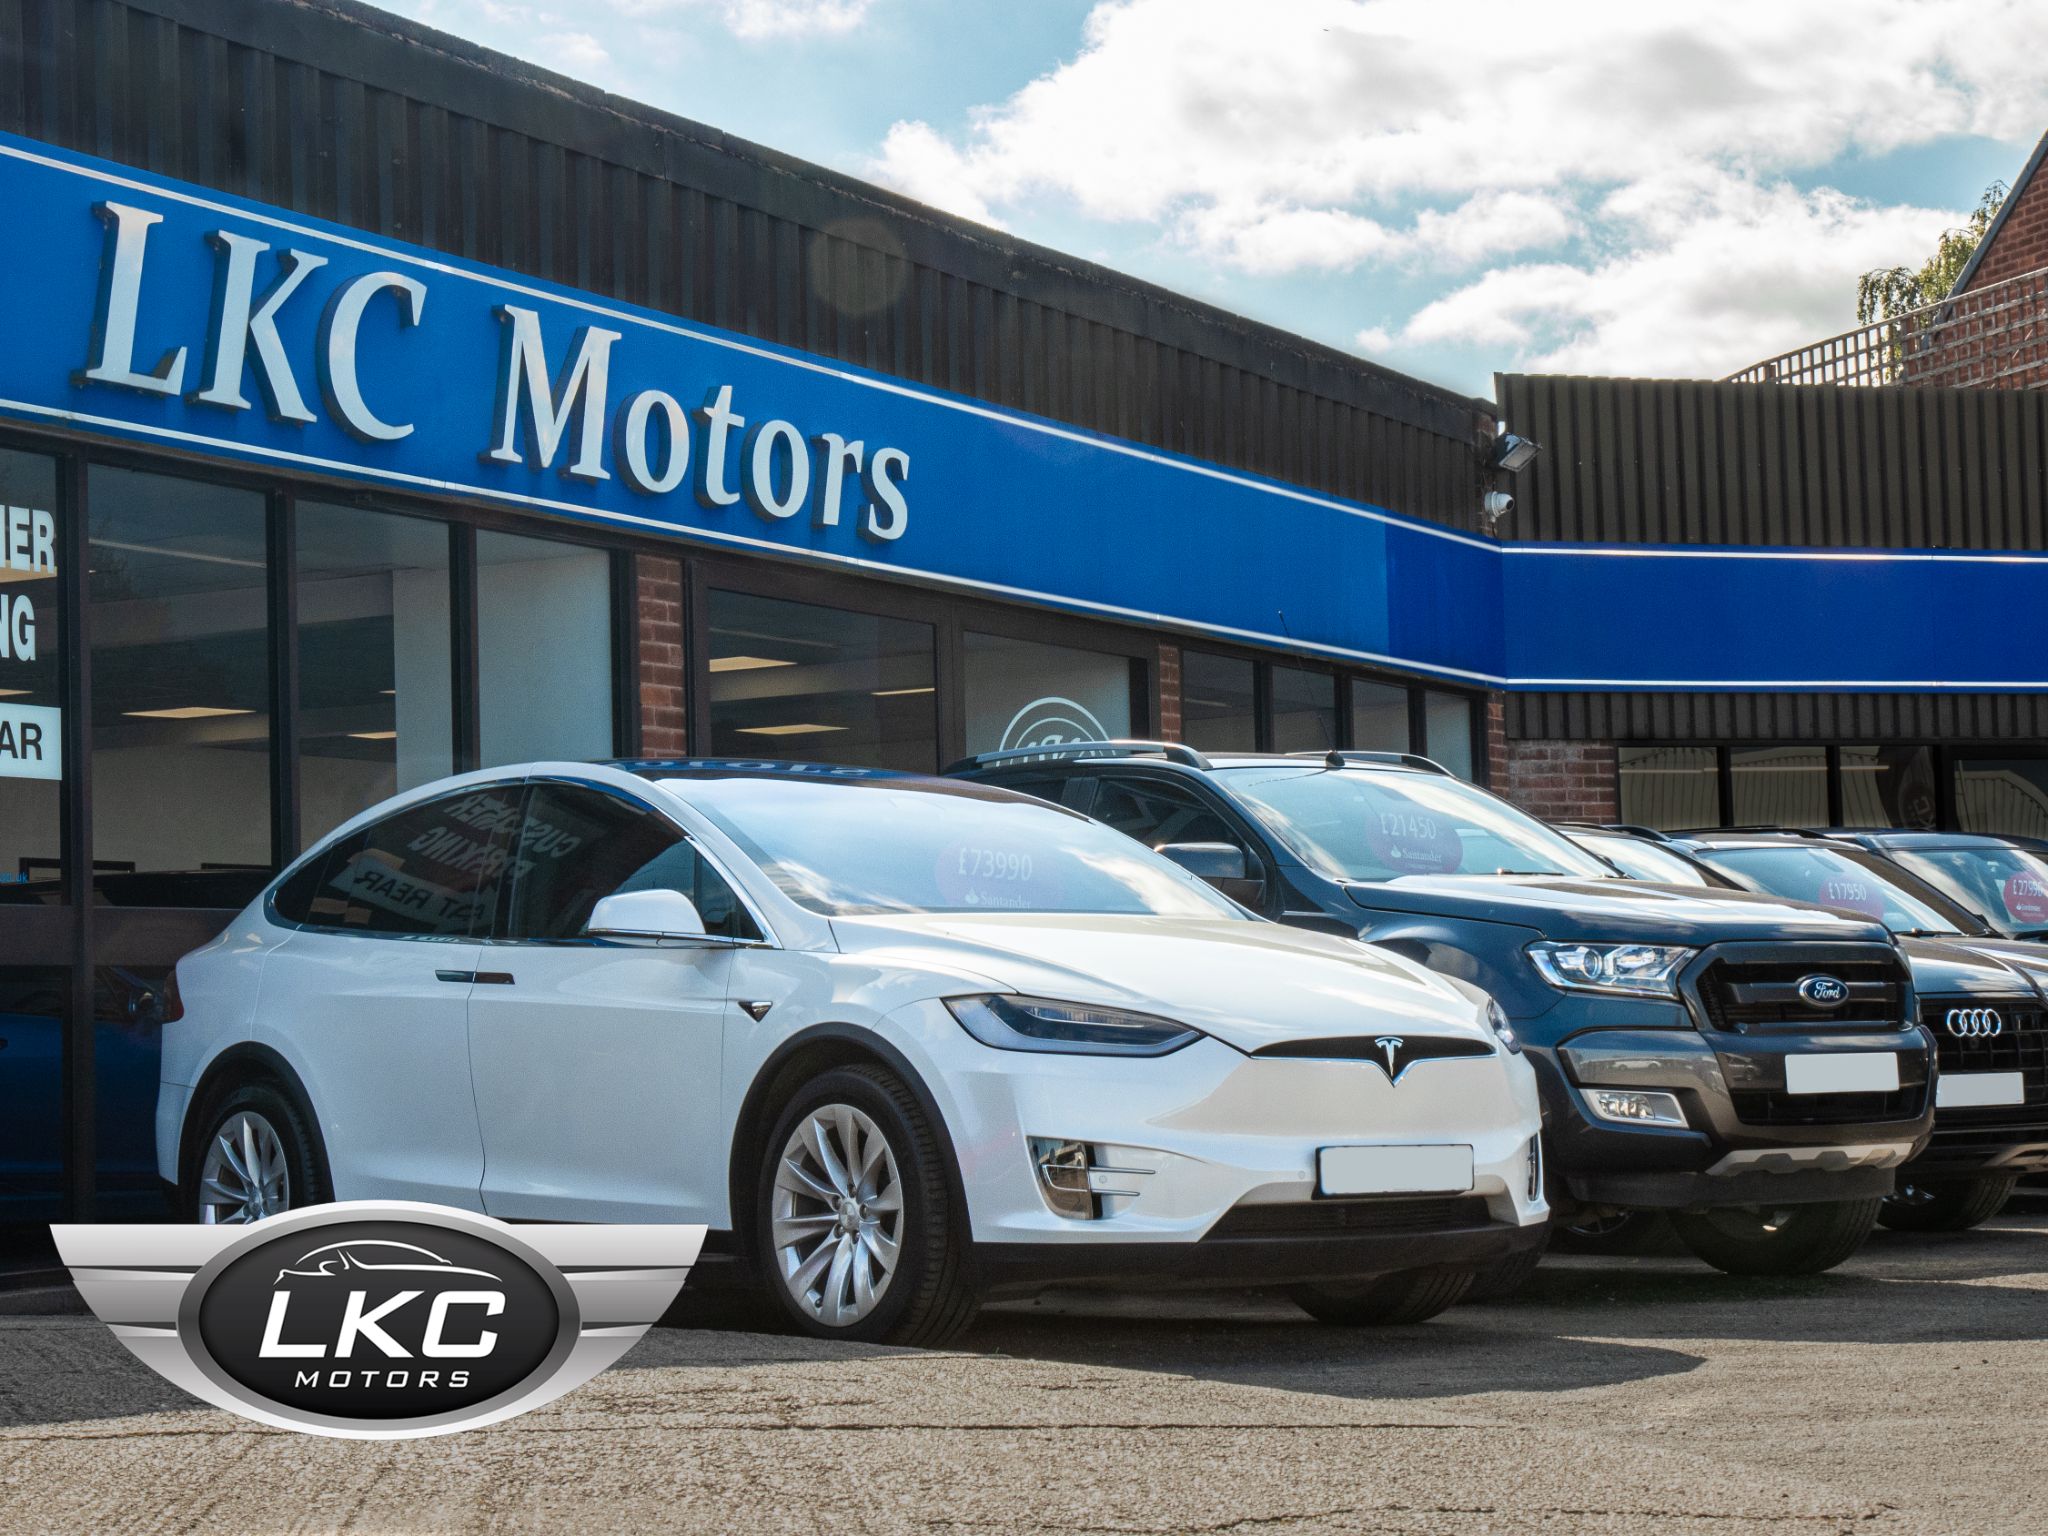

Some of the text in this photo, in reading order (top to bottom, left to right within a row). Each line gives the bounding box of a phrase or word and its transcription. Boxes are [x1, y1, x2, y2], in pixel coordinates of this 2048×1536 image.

[82, 200, 911, 541] LKC Motors
[0, 505, 55, 573] ER
[1380, 813, 1436, 839] £21450
[957, 848, 1033, 881] £73990
[1828, 882, 1867, 900] £17950
[1814, 981, 1841, 999] Ford
